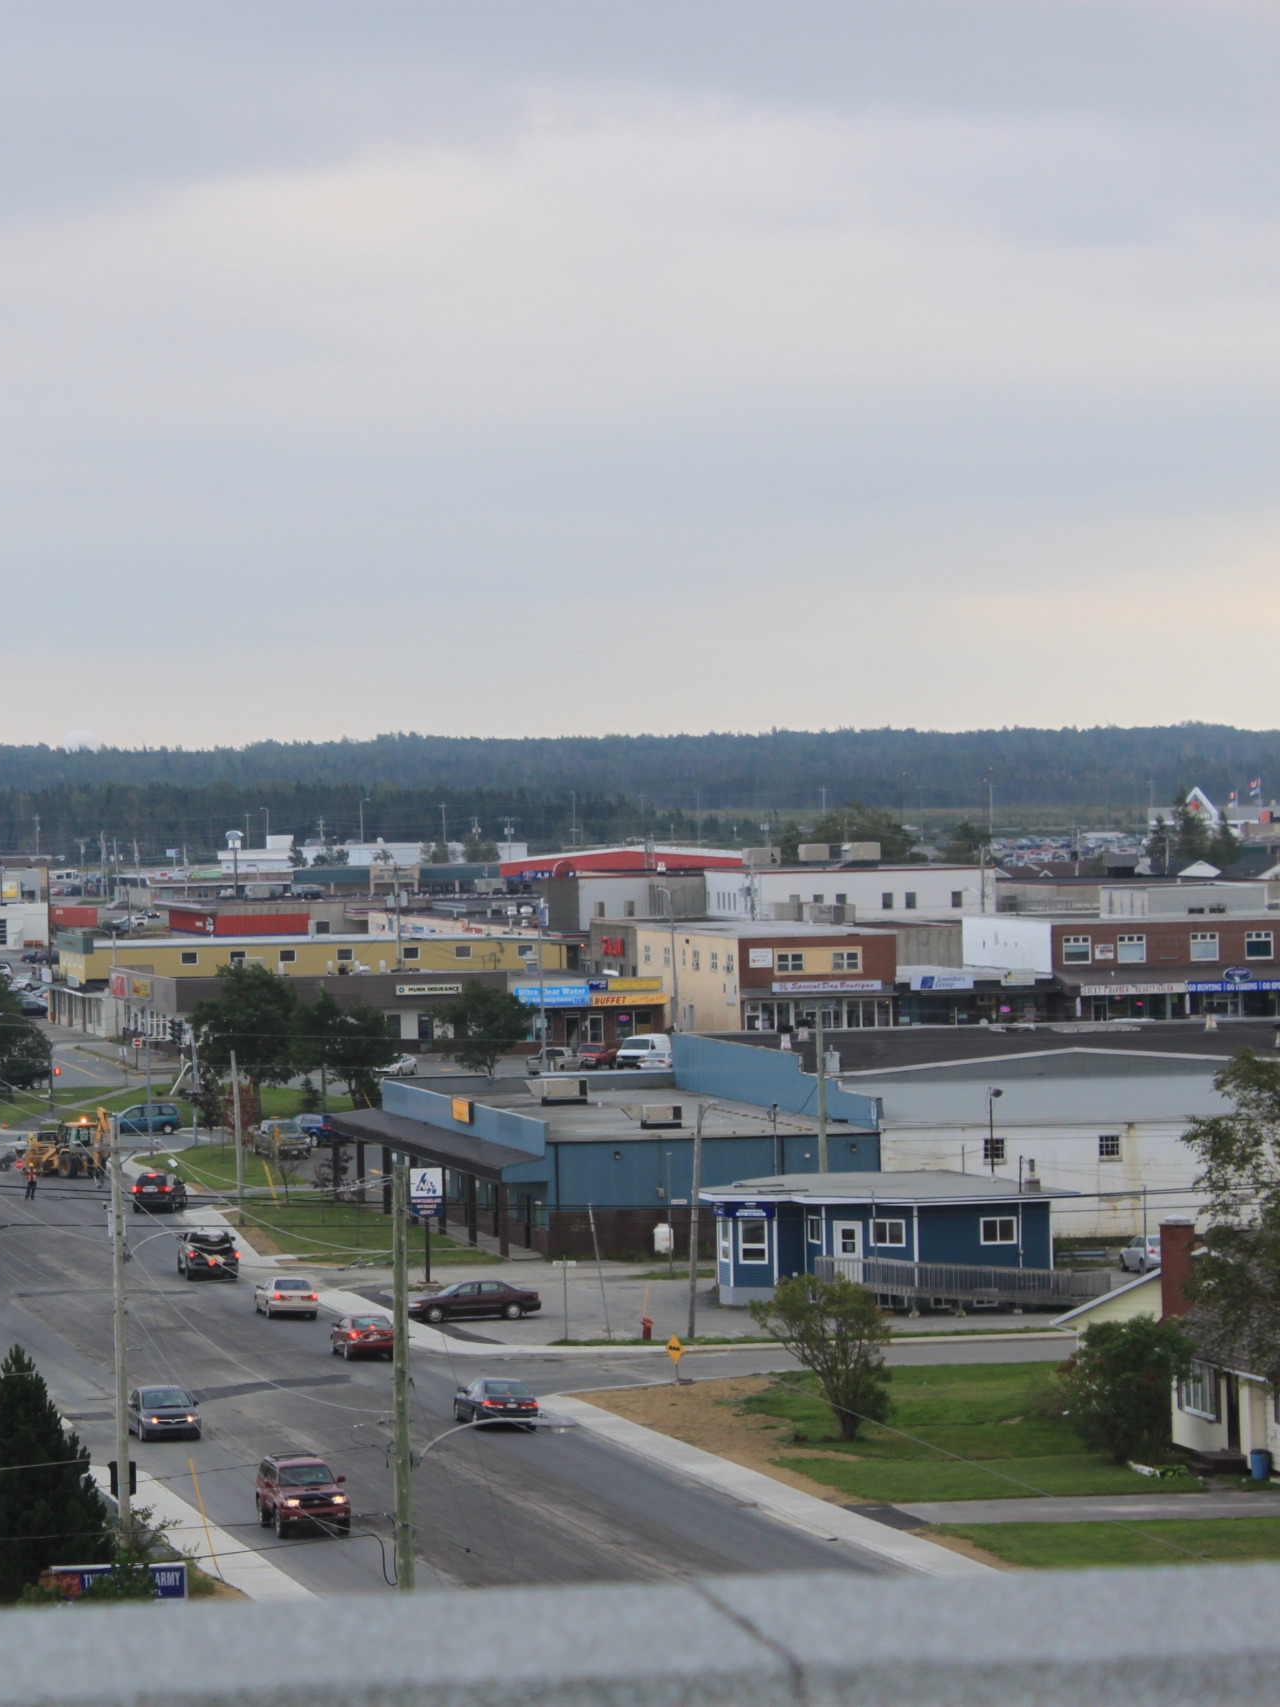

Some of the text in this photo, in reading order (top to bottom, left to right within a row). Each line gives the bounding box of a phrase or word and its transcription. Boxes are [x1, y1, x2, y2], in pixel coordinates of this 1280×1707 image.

[791, 981, 874, 990] Special Day Boutique
[1188, 983, 1222, 992] GO HUNTING
[1226, 982, 1258, 991] GO FISHING
[1262, 982, 1271, 990] GO
[562, 987, 586, 995] Water
[594, 996, 627, 1004] BUFFET
[155, 1571, 181, 1587] ARMY
